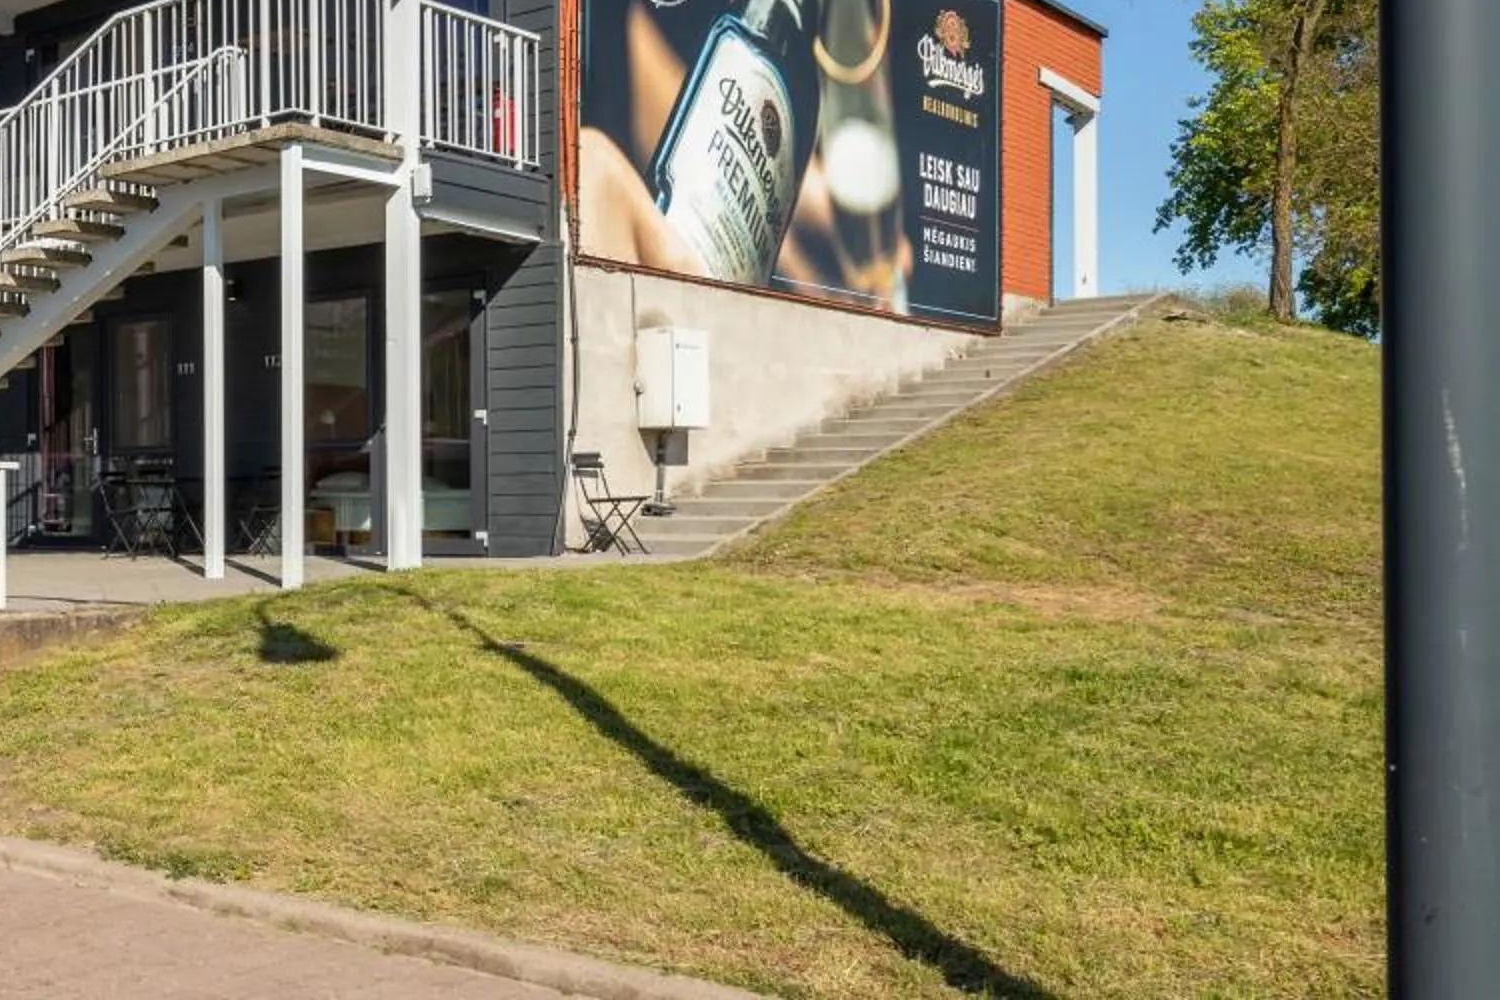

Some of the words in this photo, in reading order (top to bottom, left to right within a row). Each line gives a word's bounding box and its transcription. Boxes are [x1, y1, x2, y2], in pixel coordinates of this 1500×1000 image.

[919, 152, 953, 185] LEISK
[957, 164, 981, 193] SAU
[923, 183, 976, 219] DAUGIAU
